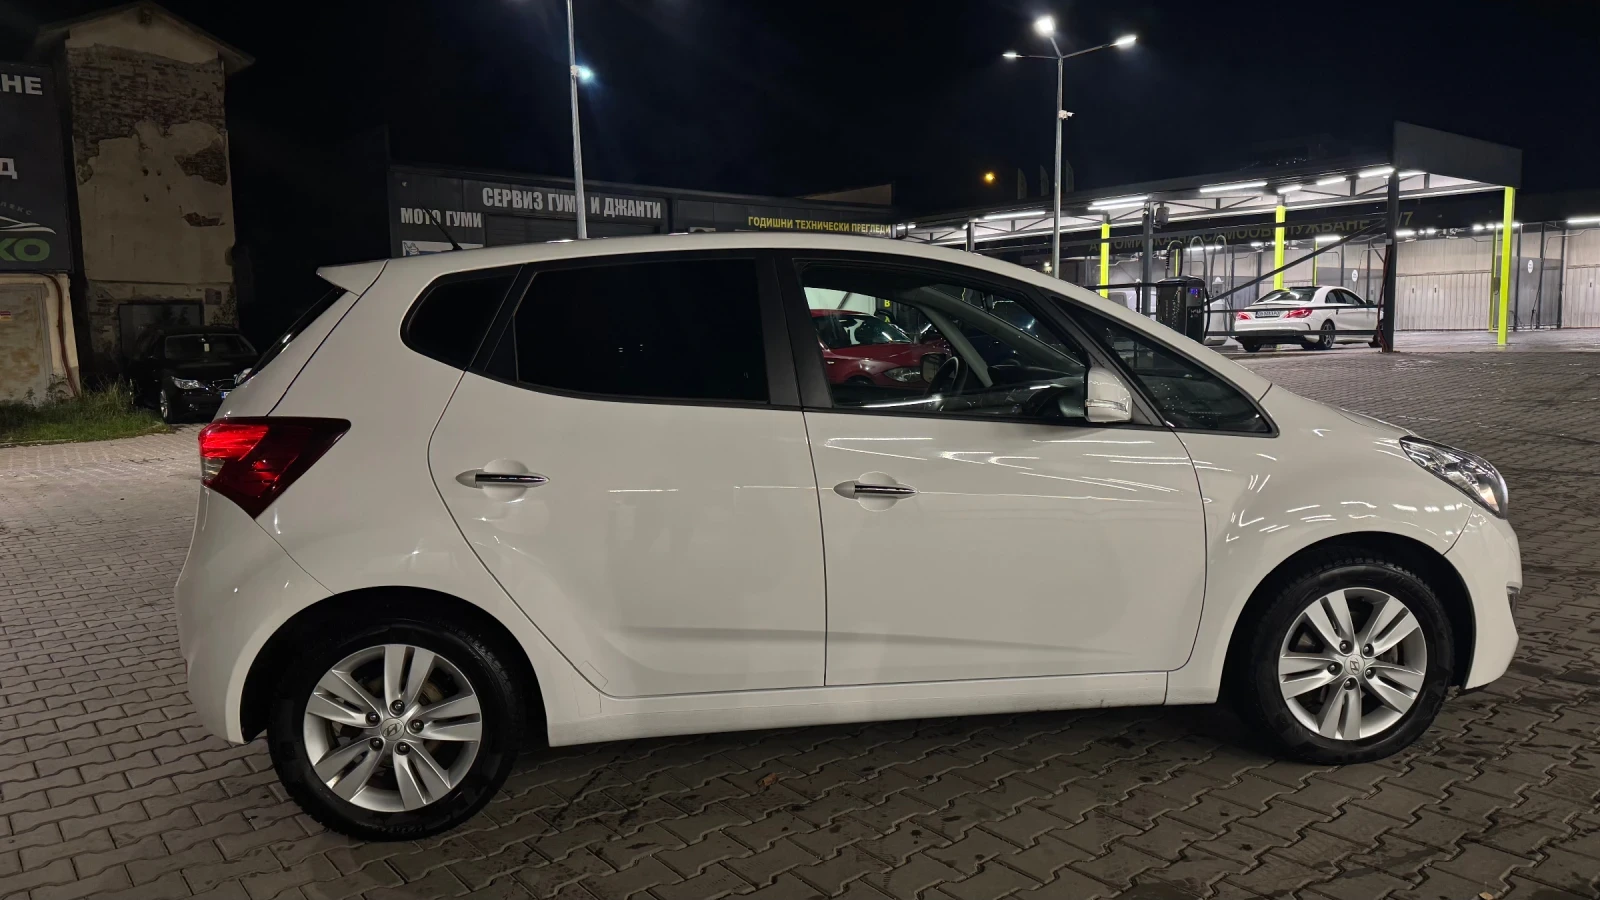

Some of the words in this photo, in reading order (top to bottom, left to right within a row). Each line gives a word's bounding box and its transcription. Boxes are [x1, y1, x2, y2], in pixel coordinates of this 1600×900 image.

[0, 74, 43, 96] НЕ
[482, 187, 543, 211] СЕРВИЗ
[547, 193, 580, 213] ГУМ
[590, 196, 600, 214] И
[604, 198, 661, 219] ДЖАНТИ
[400, 207, 442, 226] МОТО
[445, 210, 482, 228] ГУМИ
[748, 216, 794, 229] ГОДИШНИ
[795, 219, 850, 232] ТЕХНИЧЕСКИ
[851, 223, 891, 235] ПРЕГЛЕДИ
